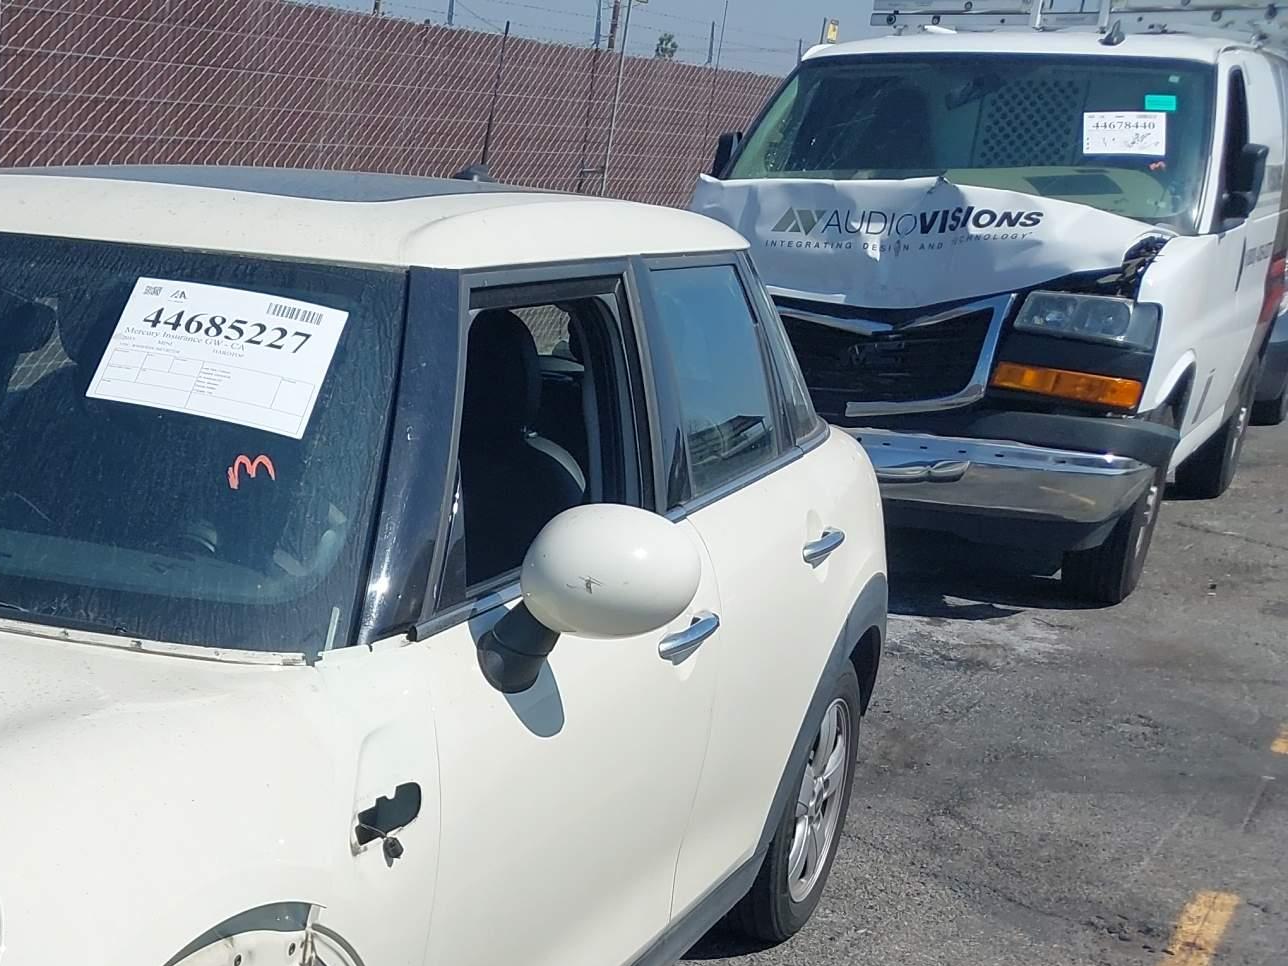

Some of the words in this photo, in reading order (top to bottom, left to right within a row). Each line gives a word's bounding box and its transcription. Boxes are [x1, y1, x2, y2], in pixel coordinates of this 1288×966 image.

[1092, 121, 1155, 130] 44678440
[821, 206, 1044, 236] AUDIOVISIONS
[765, 239, 852, 249] INTEGRATING
[919, 242, 943, 250] AND
[124, 327, 160, 338] Mercury
[162, 331, 203, 344] Insurance
[230, 342, 245, 351] CA
[143, 307, 312, 354] 44685227
